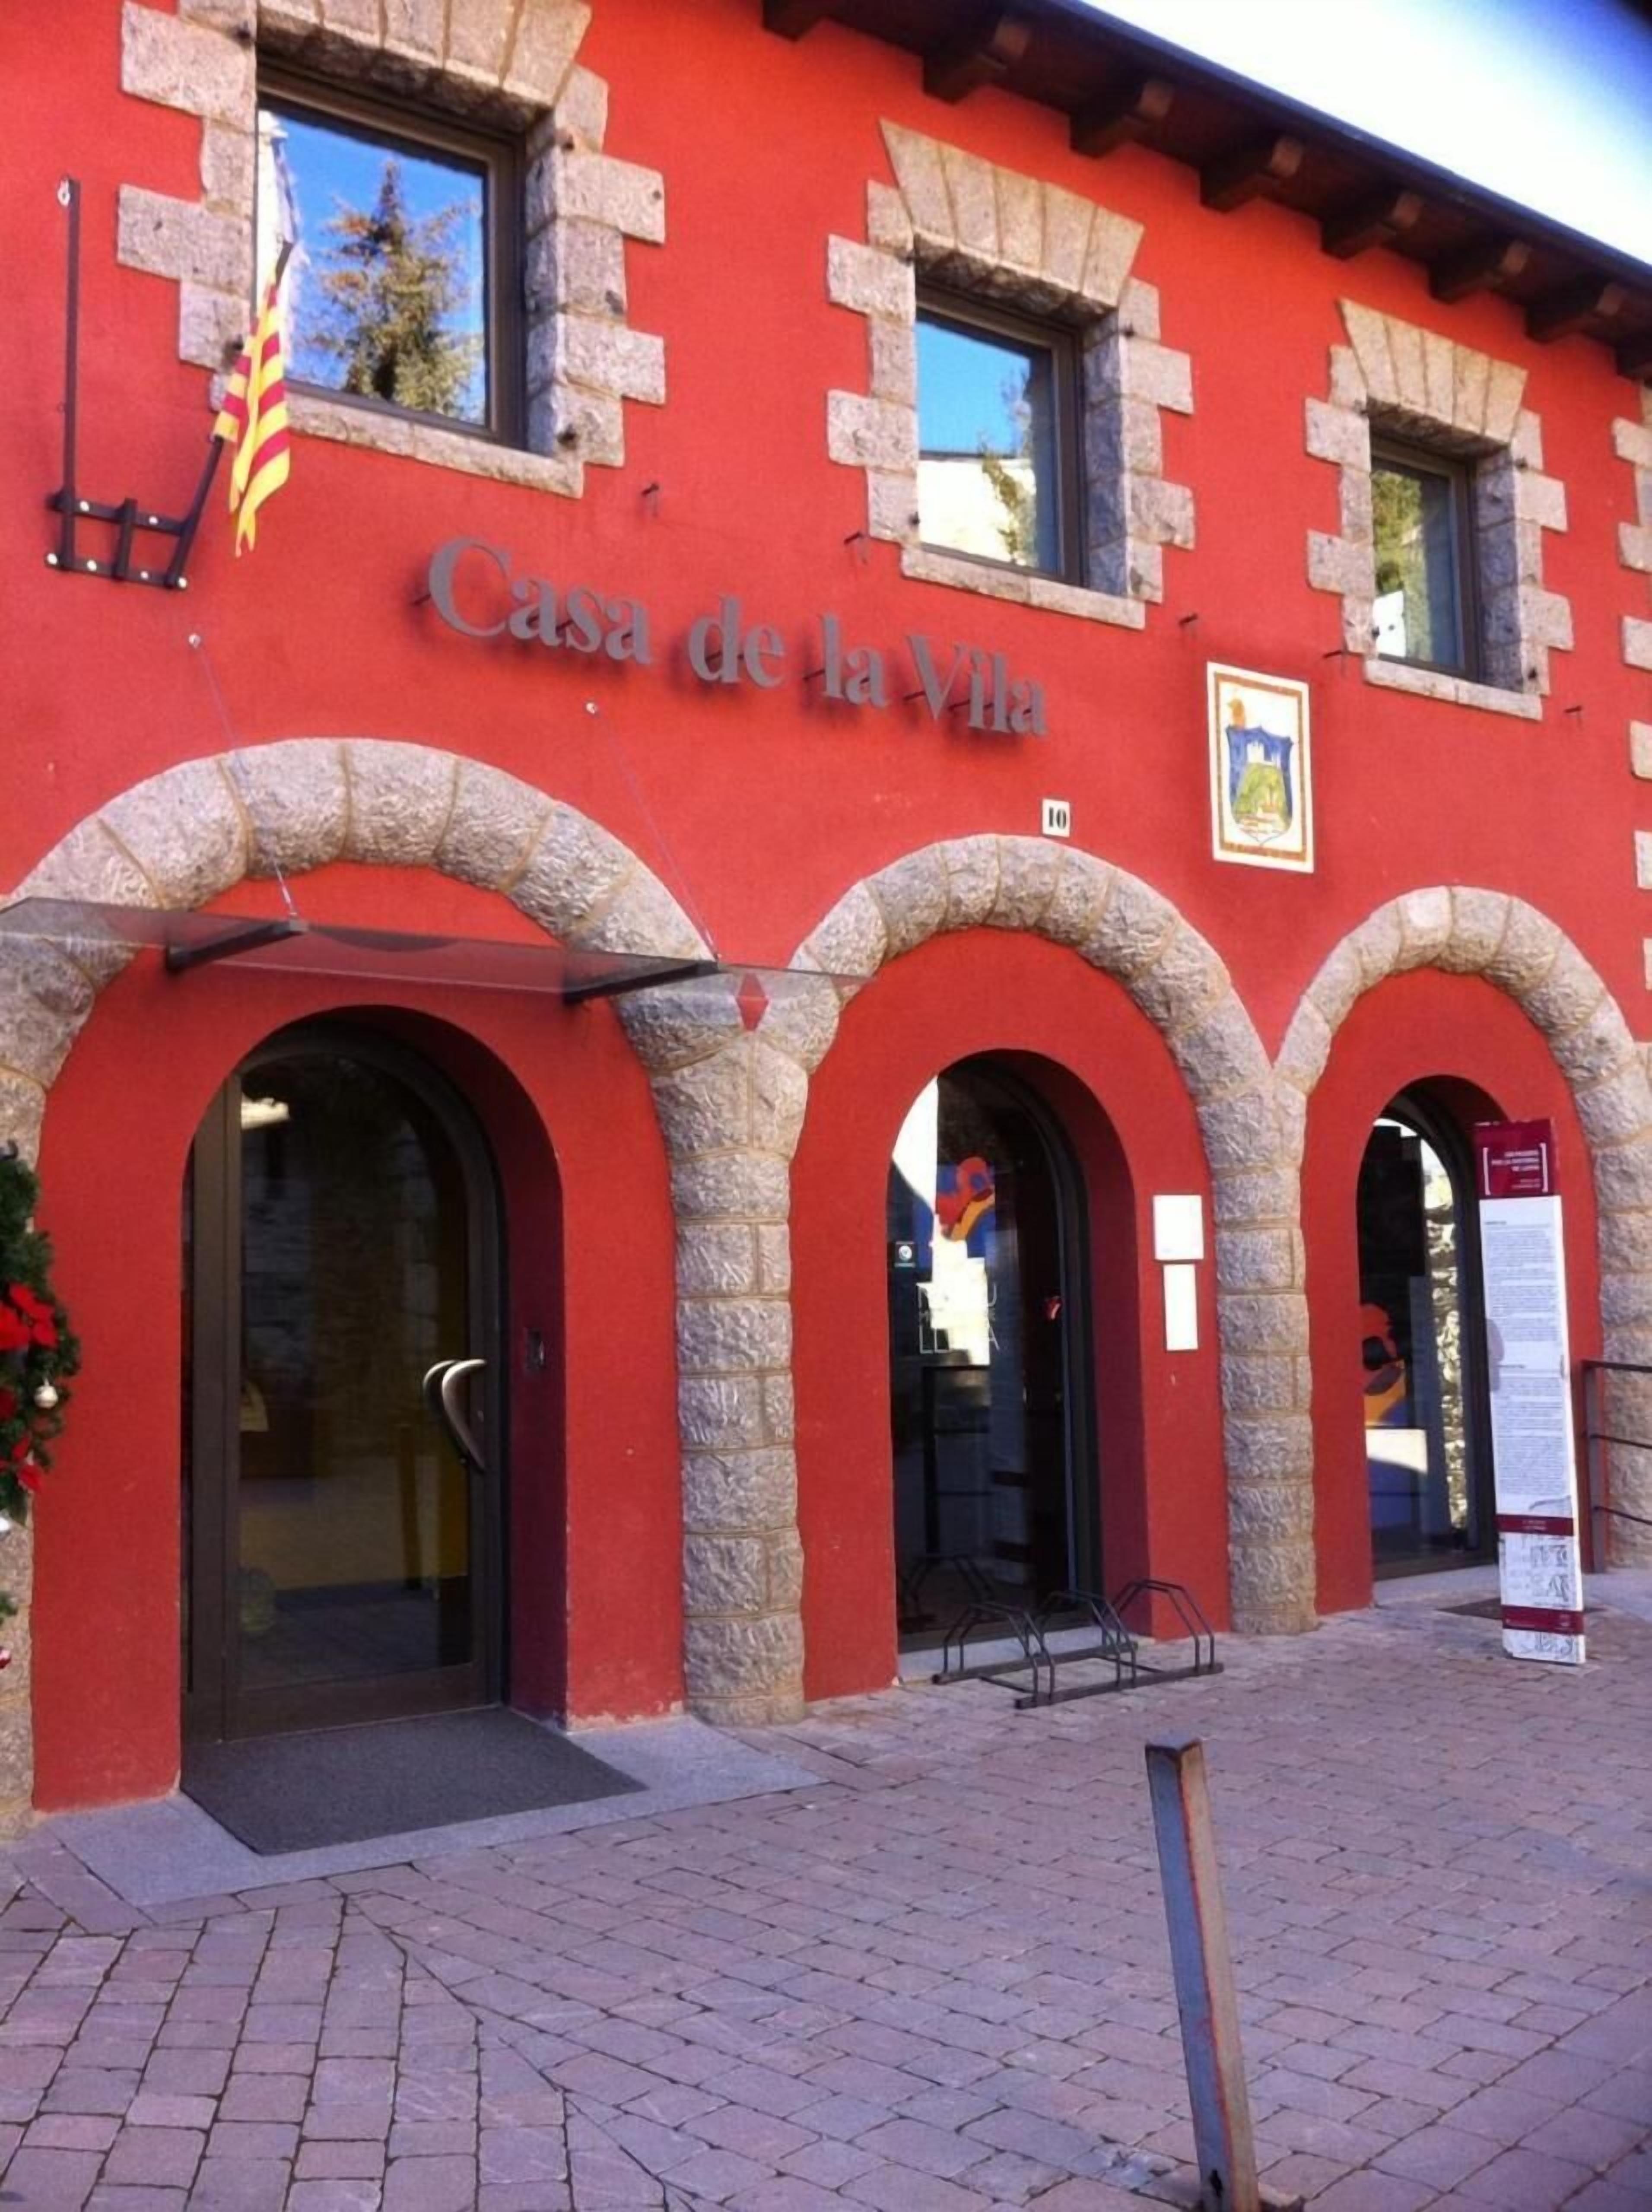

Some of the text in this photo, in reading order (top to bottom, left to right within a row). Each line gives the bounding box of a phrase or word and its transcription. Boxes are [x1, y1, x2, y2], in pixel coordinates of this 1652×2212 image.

[429, 536, 1048, 736] Casa de la Vila
[1048, 806, 1067, 830] 10
